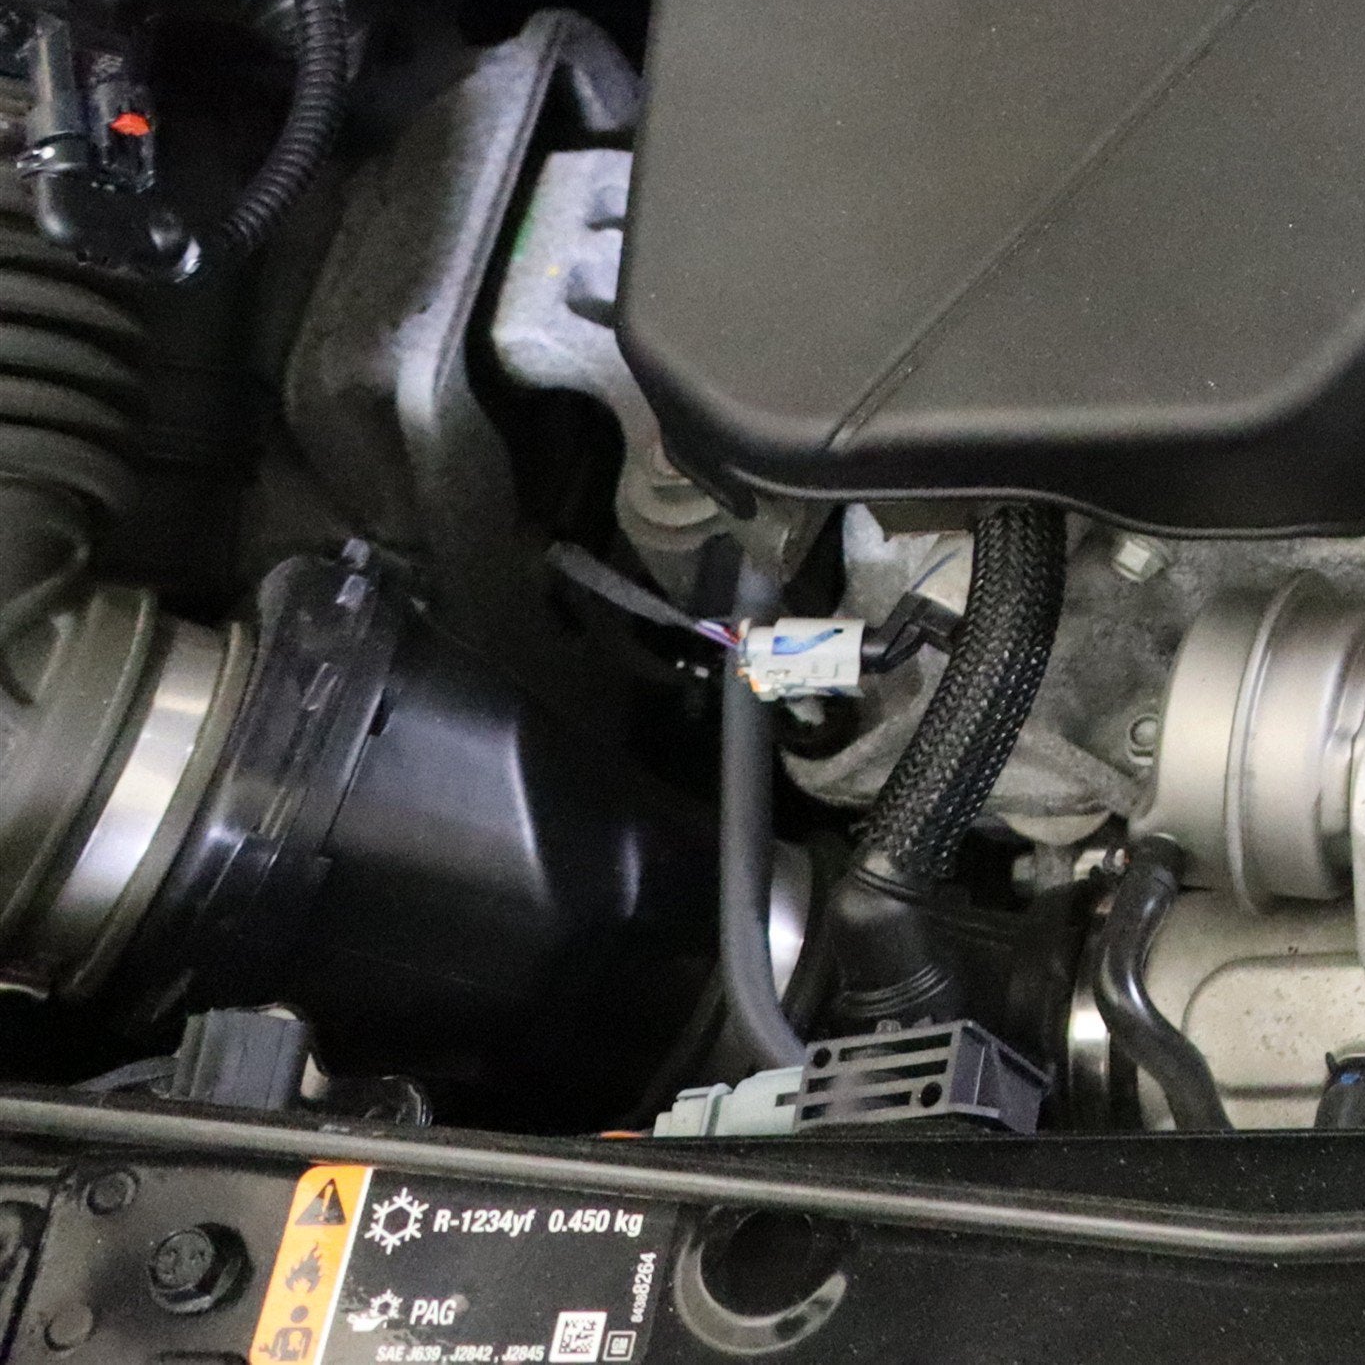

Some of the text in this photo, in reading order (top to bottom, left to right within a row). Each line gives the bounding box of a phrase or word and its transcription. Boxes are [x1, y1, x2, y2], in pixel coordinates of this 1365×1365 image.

[433, 1209, 644, 1237] R-1234yf 0.450 kg
[410, 1299, 457, 1327] PAG
[376, 1346, 404, 1362] SAE
